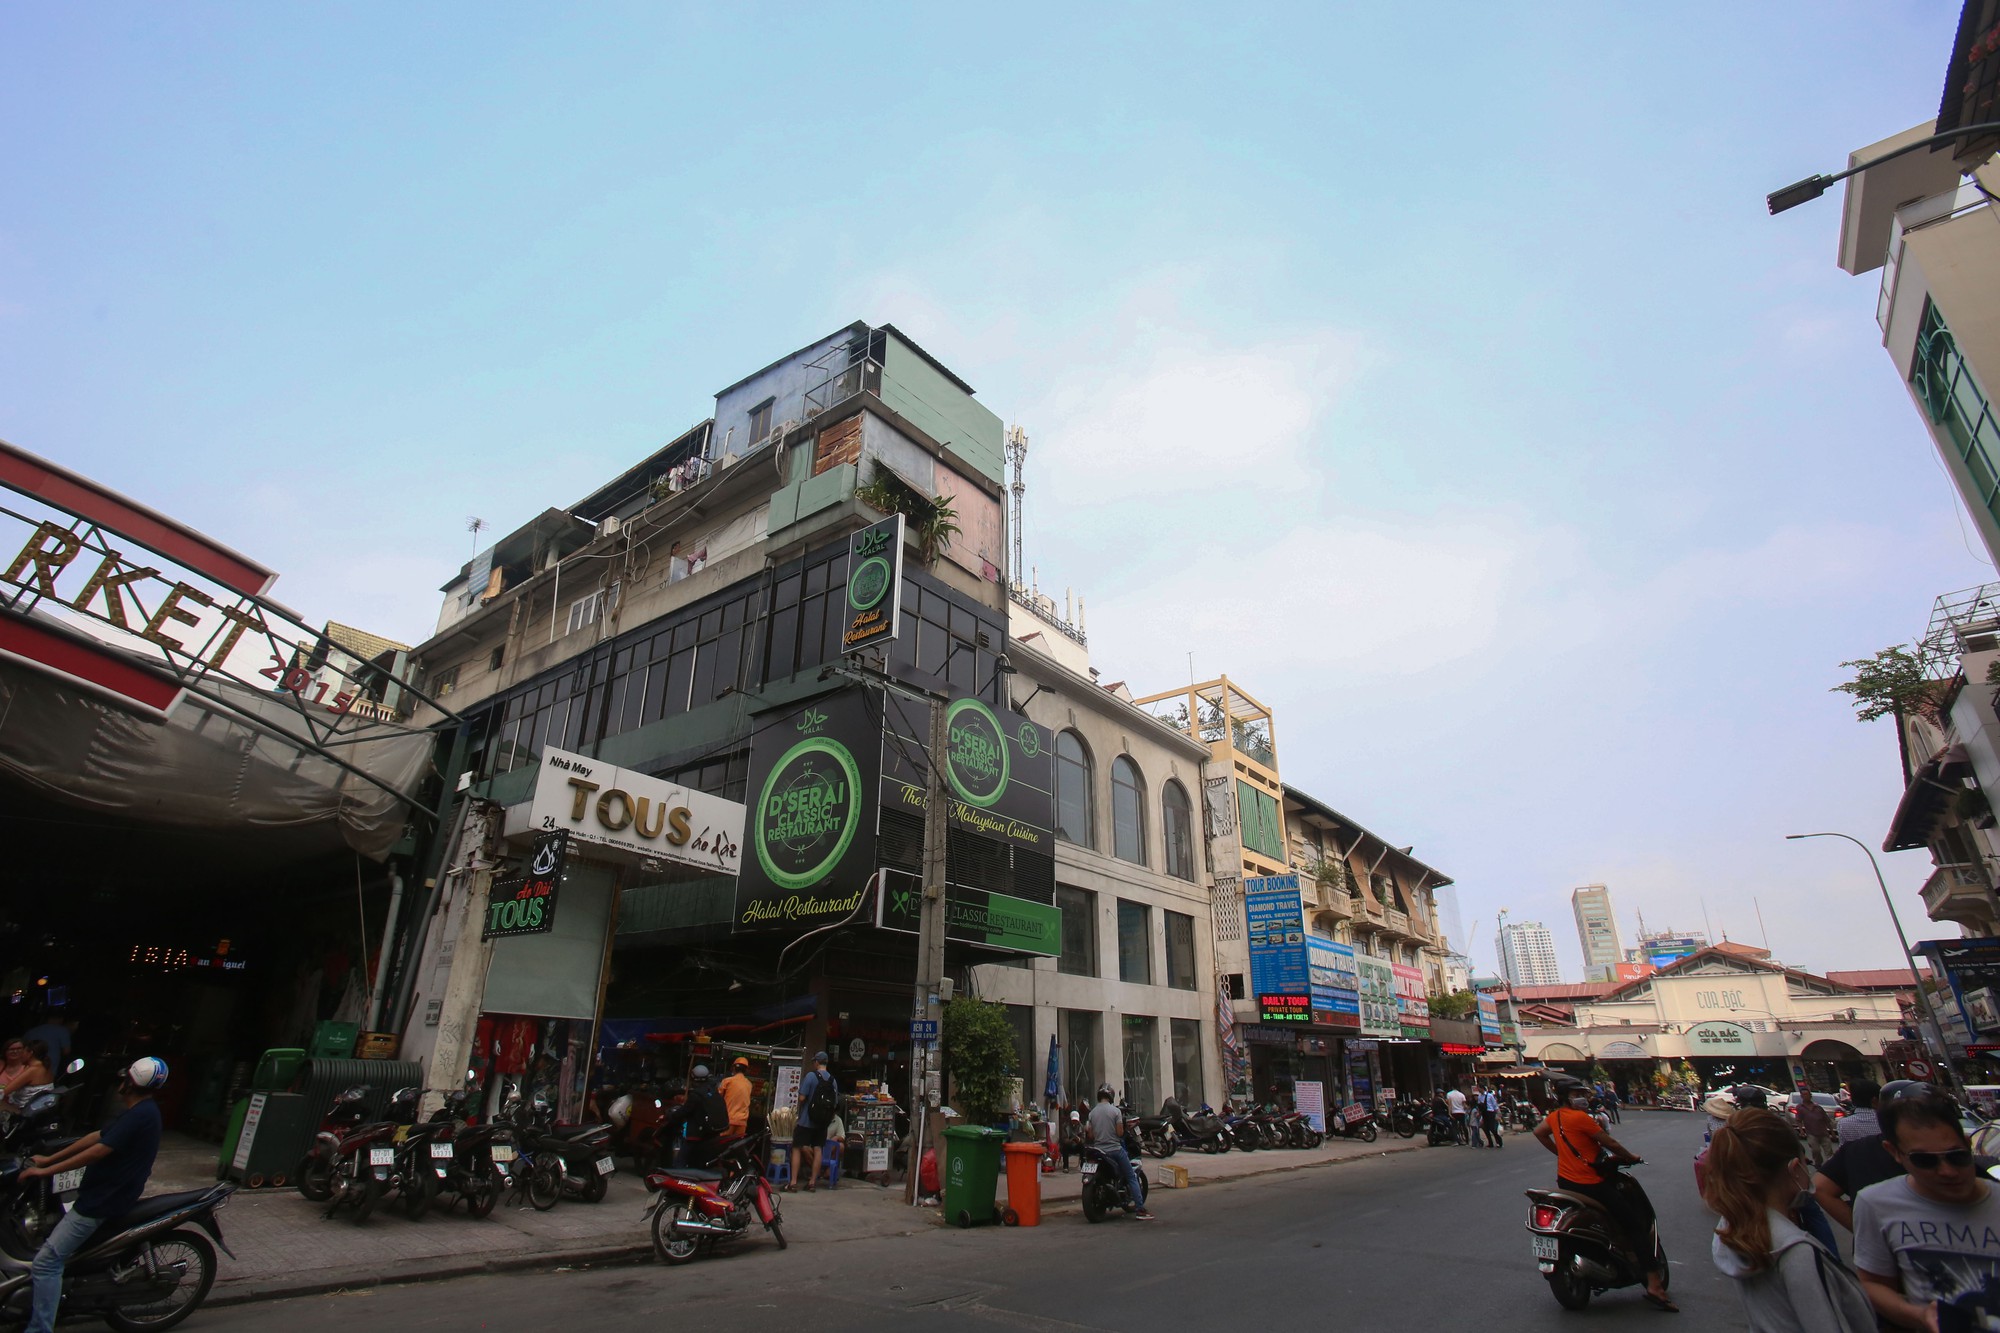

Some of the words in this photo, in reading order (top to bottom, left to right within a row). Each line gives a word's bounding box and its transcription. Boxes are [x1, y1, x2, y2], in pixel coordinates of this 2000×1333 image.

[862, 544, 885, 557] HALAL
[852, 609, 880, 629] Halal
[844, 620, 889, 645] Restaurant
[259, 655, 353, 715] 2015
[803, 725, 824, 735] HALAL
[549, 755, 570, 771] Nhà
[572, 761, 593, 778] May
[951, 752, 999, 776] RESTAURANT
[958, 745, 994, 767] CLASSIC
[543, 815, 555, 830] 24
[568, 777, 692, 846] TOUS
[779, 805, 832, 827] CLASSIC
[901, 785, 922, 806] The
[949, 802, 1005, 832] Malaysian
[1007, 820, 1039, 844] Cuisine
[768, 817, 841, 841] RESTAURANT
[1246, 879, 1265, 892] TOUR
[1267, 875, 1298, 890] BOOKING
[491, 897, 544, 930] TOUS
[742, 899, 784, 924] Halal
[784, 890, 861, 920] Restaurant
[1248, 902, 1275, 912] DIAMOND
[1276, 900, 1299, 910] TRAVEL
[951, 905, 988, 924] CLASSIC
[989, 912, 1044, 935] RESTAURANT
[1262, 996, 1286, 1006] DAILY
[1287, 996, 1309, 1006] TOUR
[1901, 1221, 2000, 1249] ARMA
